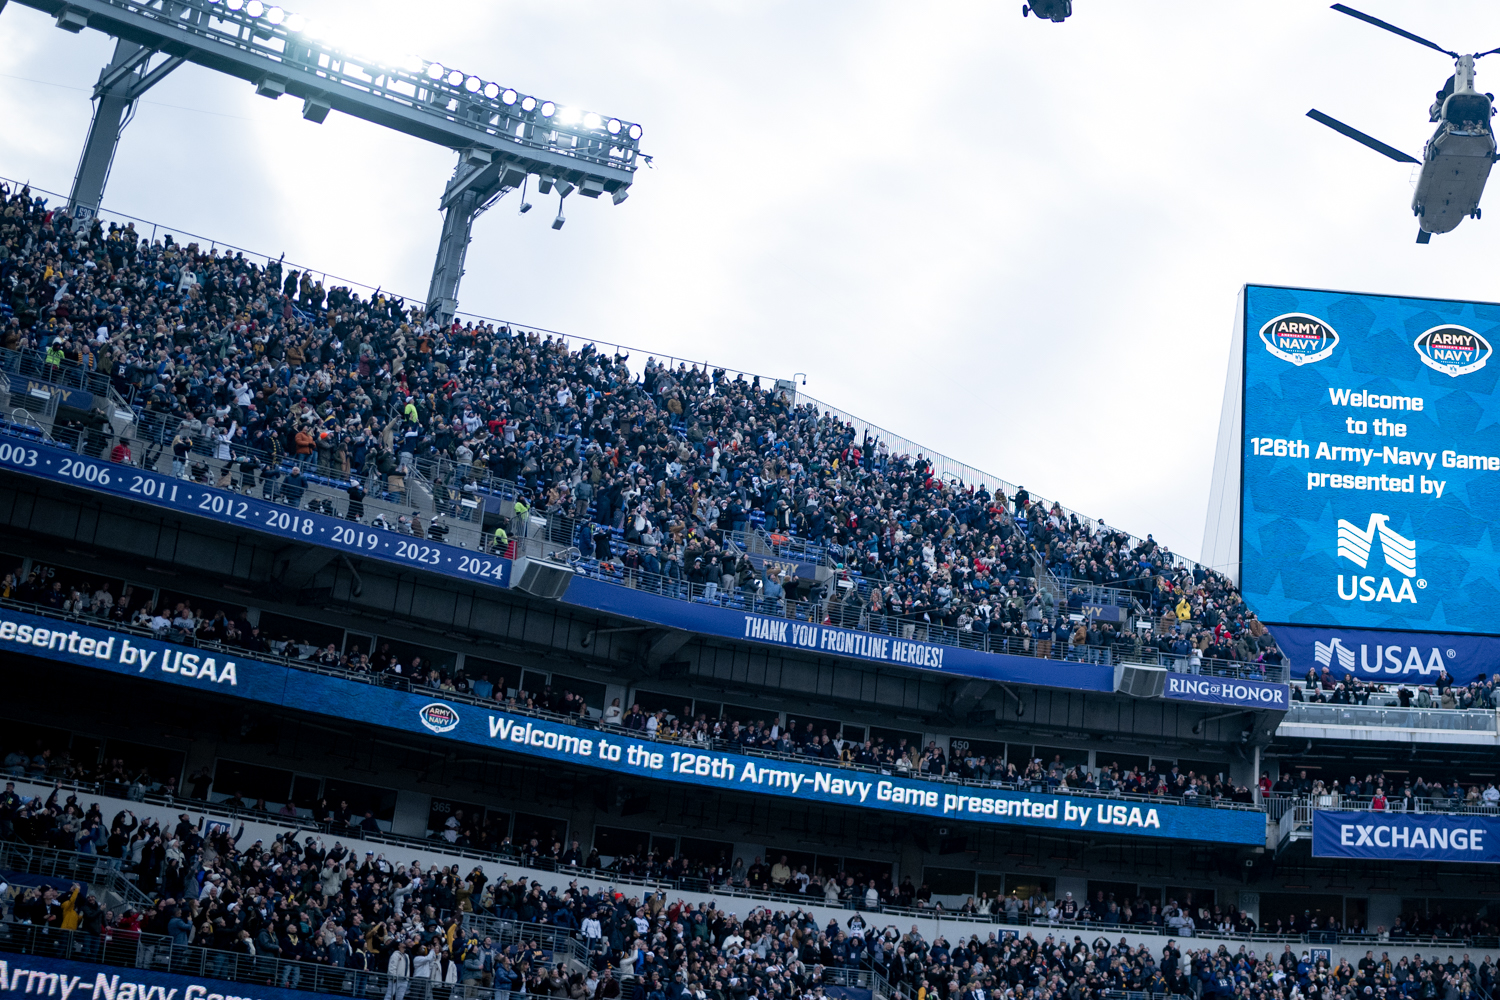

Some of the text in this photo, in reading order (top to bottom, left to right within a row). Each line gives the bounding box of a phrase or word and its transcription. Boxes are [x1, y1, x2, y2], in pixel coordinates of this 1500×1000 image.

[1278, 321, 1320, 334] ARMY
[1280, 338, 1319, 350] NAVY
[1432, 333, 1473, 346] ARMY
[1434, 349, 1473, 361] NAVY
[1328, 387, 1424, 411] Welcome
[1346, 417, 1407, 437] to the
[1250, 437, 1500, 471] 126th Army-Navy Game
[1307, 472, 1446, 498] presented by
[57, 458, 111, 485] 2006
[129, 475, 178, 501] 2011
[199, 492, 249, 520] 2012
[265, 510, 314, 536] 2018
[331, 525, 379, 550] 2019
[395, 541, 441, 565] 2023
[457, 555, 503, 580] 2024
[33, 565, 56, 579] 45
[745, 616, 943, 668] THANK YOU FRONTLINE HEROES!
[0, 620, 238, 686] esented by USAA
[1169, 678, 1283, 703] RING OF HONOR
[428, 716, 449, 725] NAVY
[429, 707, 451, 717] ARMY
[951, 740, 969, 750] 450
[488, 715, 1161, 829] Welcome to the 126th Army-Navy Game presented by USAA
[432, 801, 451, 813] 365
[1341, 824, 1483, 851] EXCHANGE
[1065, 905, 1074, 914] 12
